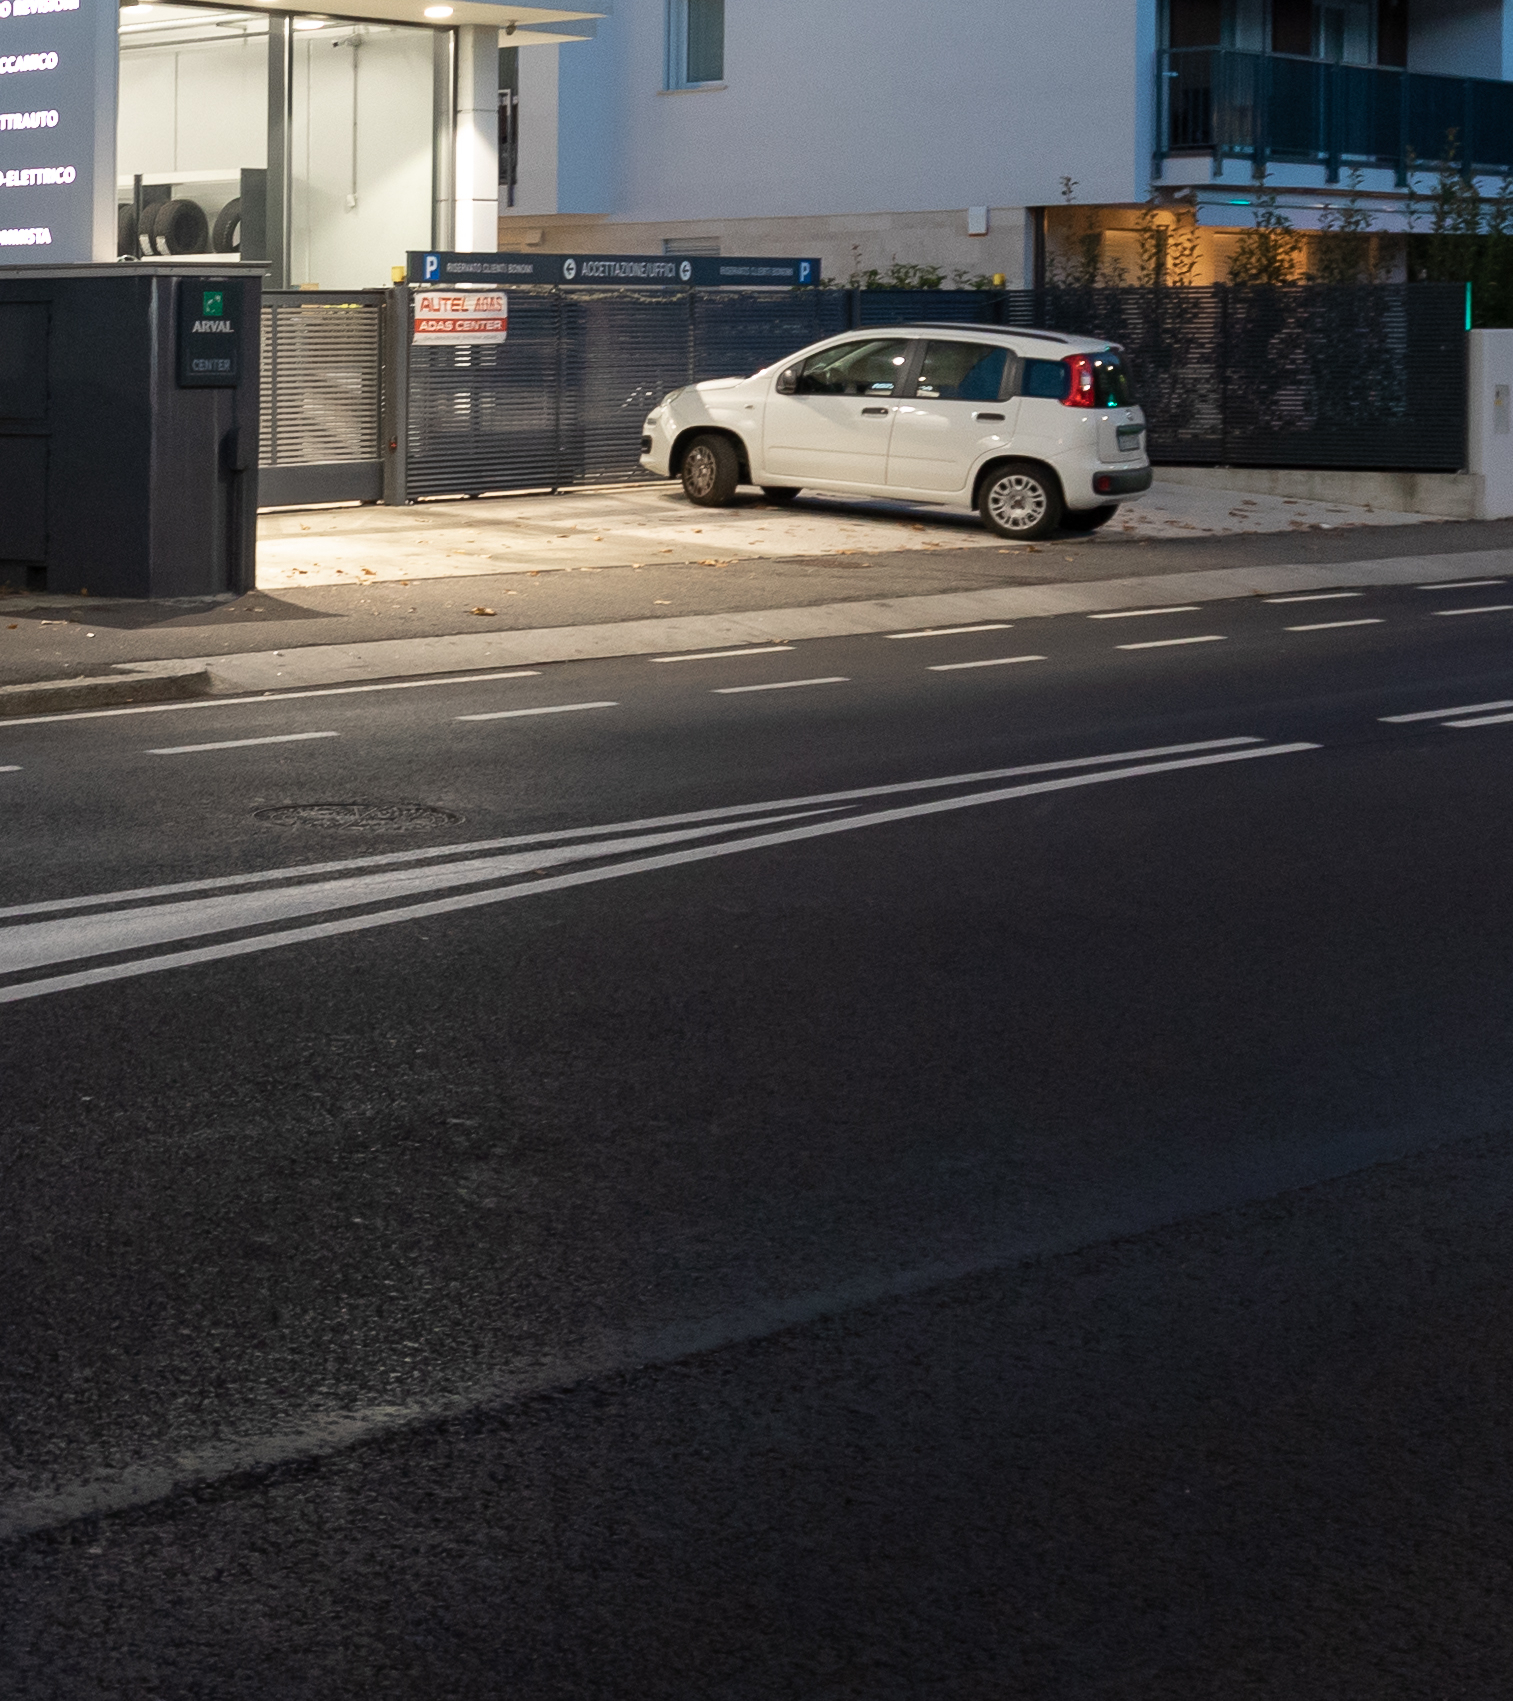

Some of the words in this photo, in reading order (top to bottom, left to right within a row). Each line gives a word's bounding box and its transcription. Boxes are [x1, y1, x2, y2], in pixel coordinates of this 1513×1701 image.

[425, 255, 438, 279] P
[799, 261, 811, 282] P
[419, 297, 469, 313] AUTEL
[192, 320, 235, 333] ARVAL
[418, 320, 454, 332] ADAS
[456, 320, 503, 331] CENTER
[192, 359, 231, 371] CENTER
